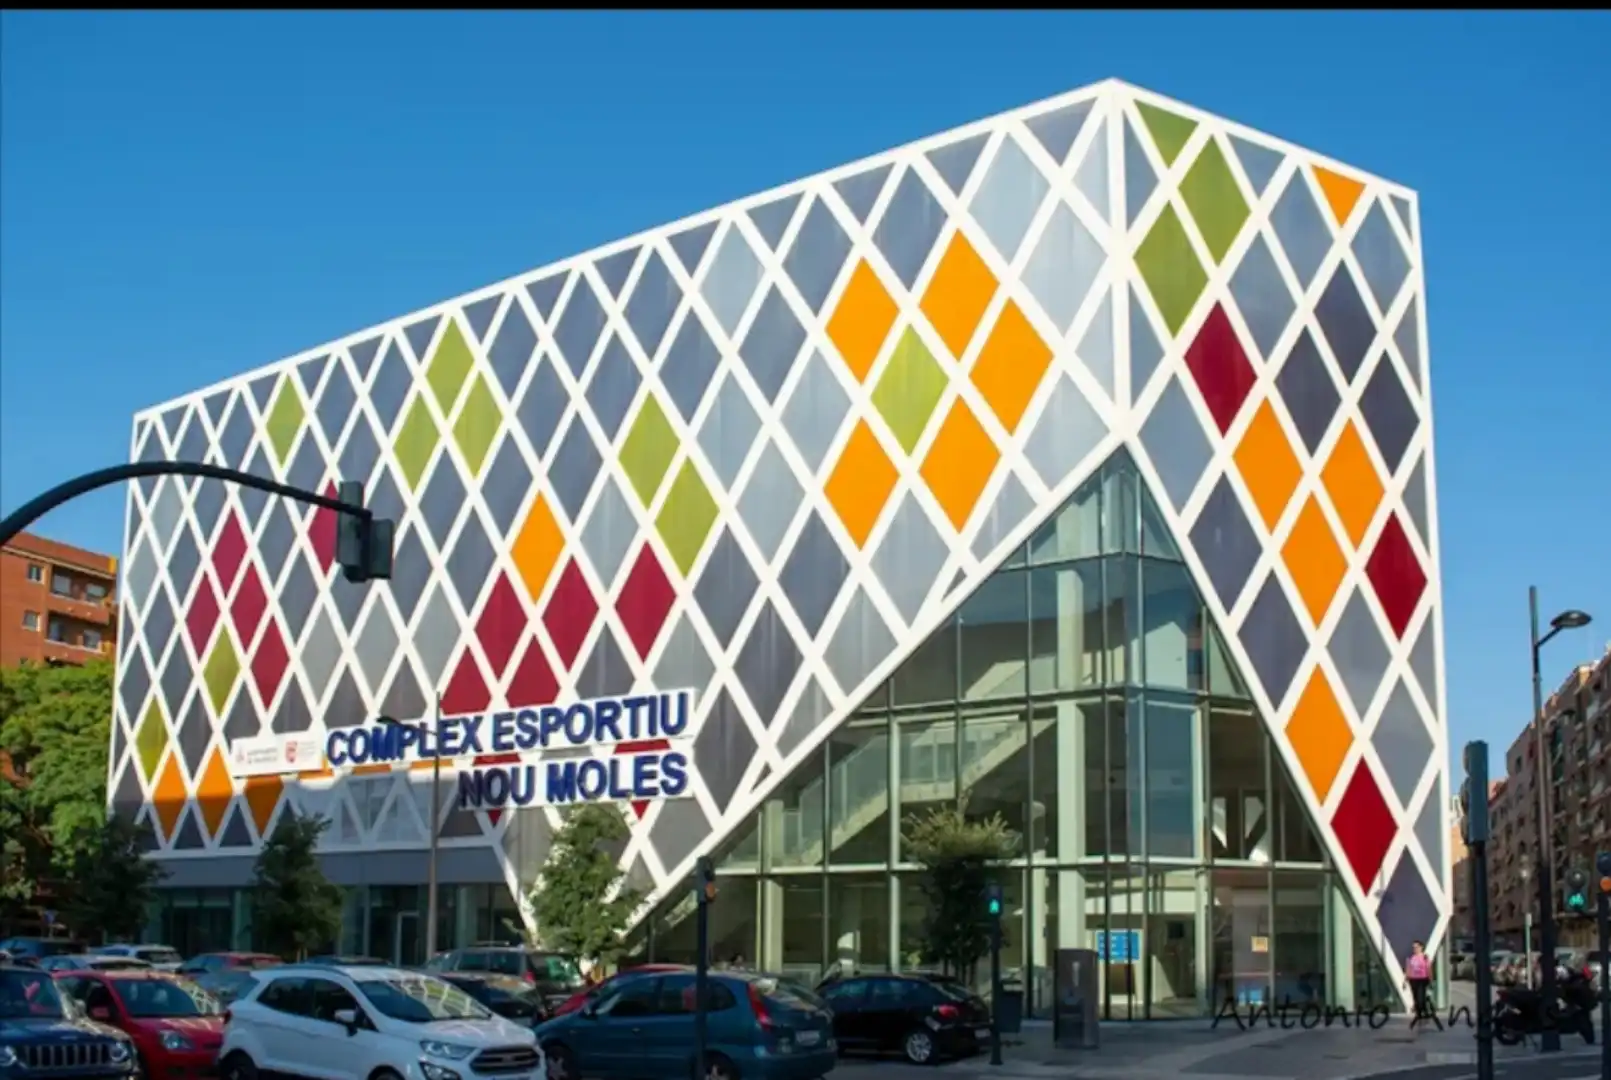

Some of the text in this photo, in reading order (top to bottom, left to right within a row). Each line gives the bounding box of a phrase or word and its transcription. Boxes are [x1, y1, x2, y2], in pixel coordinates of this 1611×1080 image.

[327, 715, 484, 766] COMPLEX
[492, 692, 688, 752] ESPORTIU
[458, 752, 688, 808] NOU MOLES
